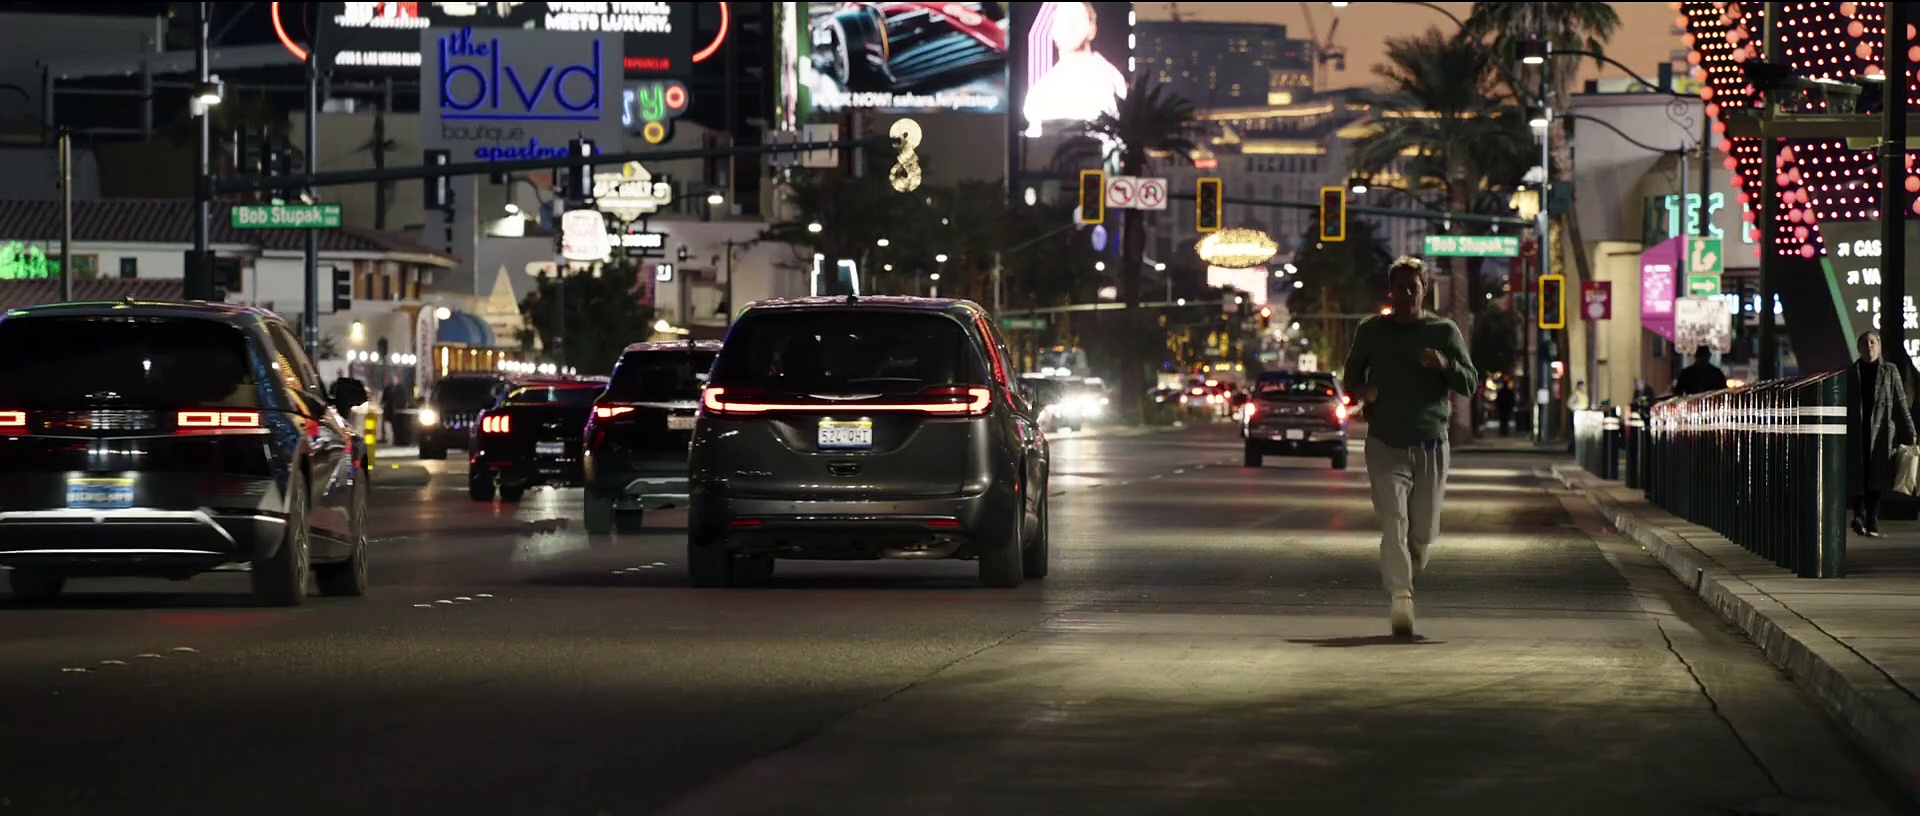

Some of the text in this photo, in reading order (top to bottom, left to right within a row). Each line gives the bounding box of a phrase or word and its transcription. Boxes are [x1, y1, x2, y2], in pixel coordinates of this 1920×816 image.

[545, 12, 672, 33] MEETS LUXURY.
[450, 26, 489, 56] the
[439, 37, 602, 112] blvd
[239, 206, 268, 224] Bob
[271, 206, 322, 227] Stupak
[1432, 235, 1457, 252] Bob
[1459, 236, 1503, 256] Stupak
